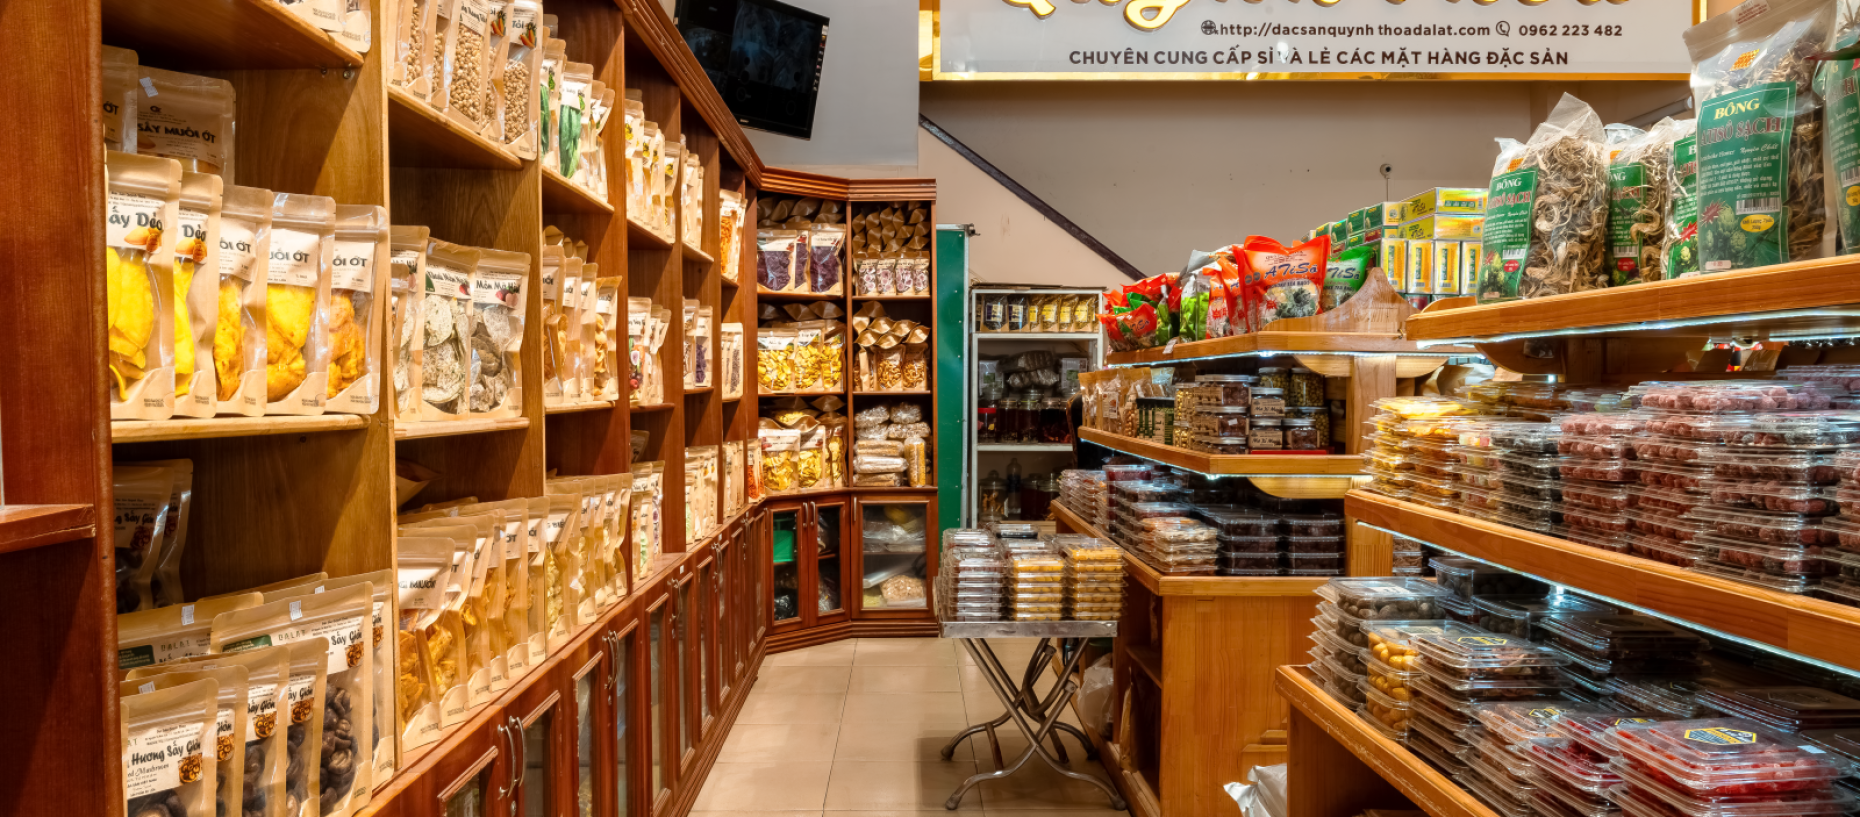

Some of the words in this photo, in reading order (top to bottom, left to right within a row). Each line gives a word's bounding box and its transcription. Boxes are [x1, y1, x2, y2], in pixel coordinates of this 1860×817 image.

[1518, 24, 1558, 37] 0962
[1561, 24, 1590, 37] 223
[1594, 24, 1623, 37] 482
[1069, 47, 1148, 65] CHUYÊN
[1154, 50, 1208, 65] CUNG
[1213, 44, 1251, 65] CẤP
[1309, 46, 1331, 65] LẺ
[1336, 46, 1376, 65] CÁC
[1381, 47, 1422, 68] MẶT
[1428, 46, 1481, 65] HÀNG
[1486, 47, 1524, 68] ĐẶC
[1530, 47, 1568, 65] SẢN
[1714, 98, 1760, 120] BÔNG
[1736, 116, 1783, 141] SẠCH
[1496, 178, 1522, 191] BÔNG
[1506, 191, 1531, 207] SẠCH
[236, 241, 251, 253] ỚT
[293, 250, 310, 263] ỚT
[350, 255, 368, 267] ỚT
[131, 749, 165, 766] Hương
[166, 740, 184, 757] Sấy
